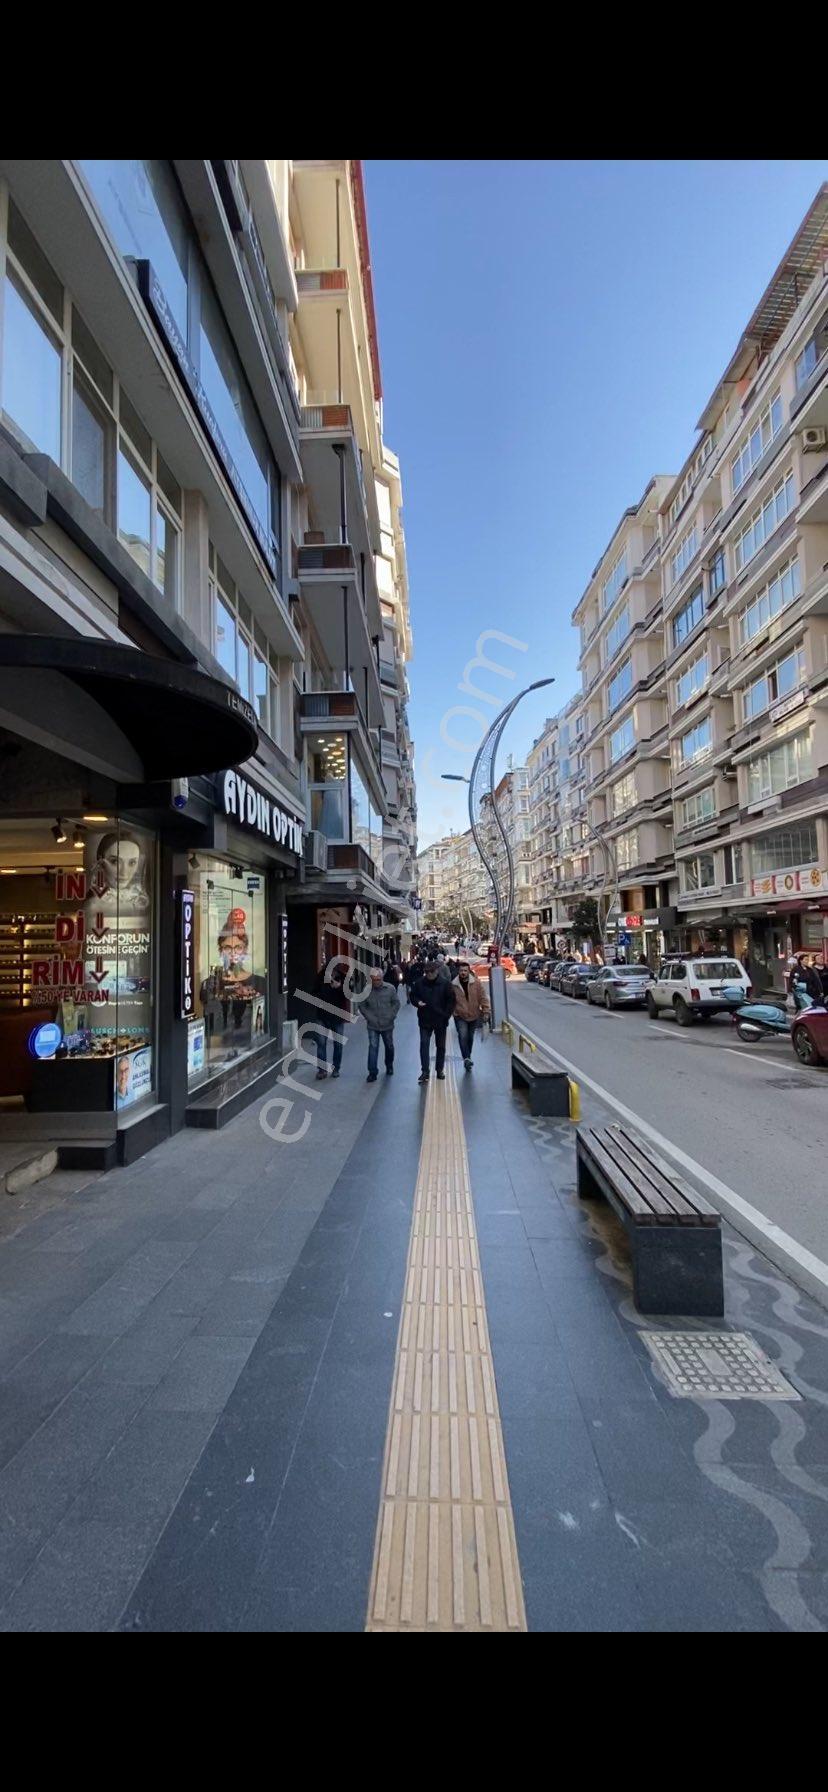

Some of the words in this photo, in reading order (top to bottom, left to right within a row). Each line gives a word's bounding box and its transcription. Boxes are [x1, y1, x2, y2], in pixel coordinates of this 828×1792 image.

[224, 769, 270, 836] AYDIN
[272, 806, 304, 858] OPTİK
[56, 868, 87, 900] İN
[55, 909, 85, 943] Dİ
[86, 933, 150, 945] KONFORUN
[31, 954, 85, 987] RİM
[72, 988, 110, 1003] VARAN
